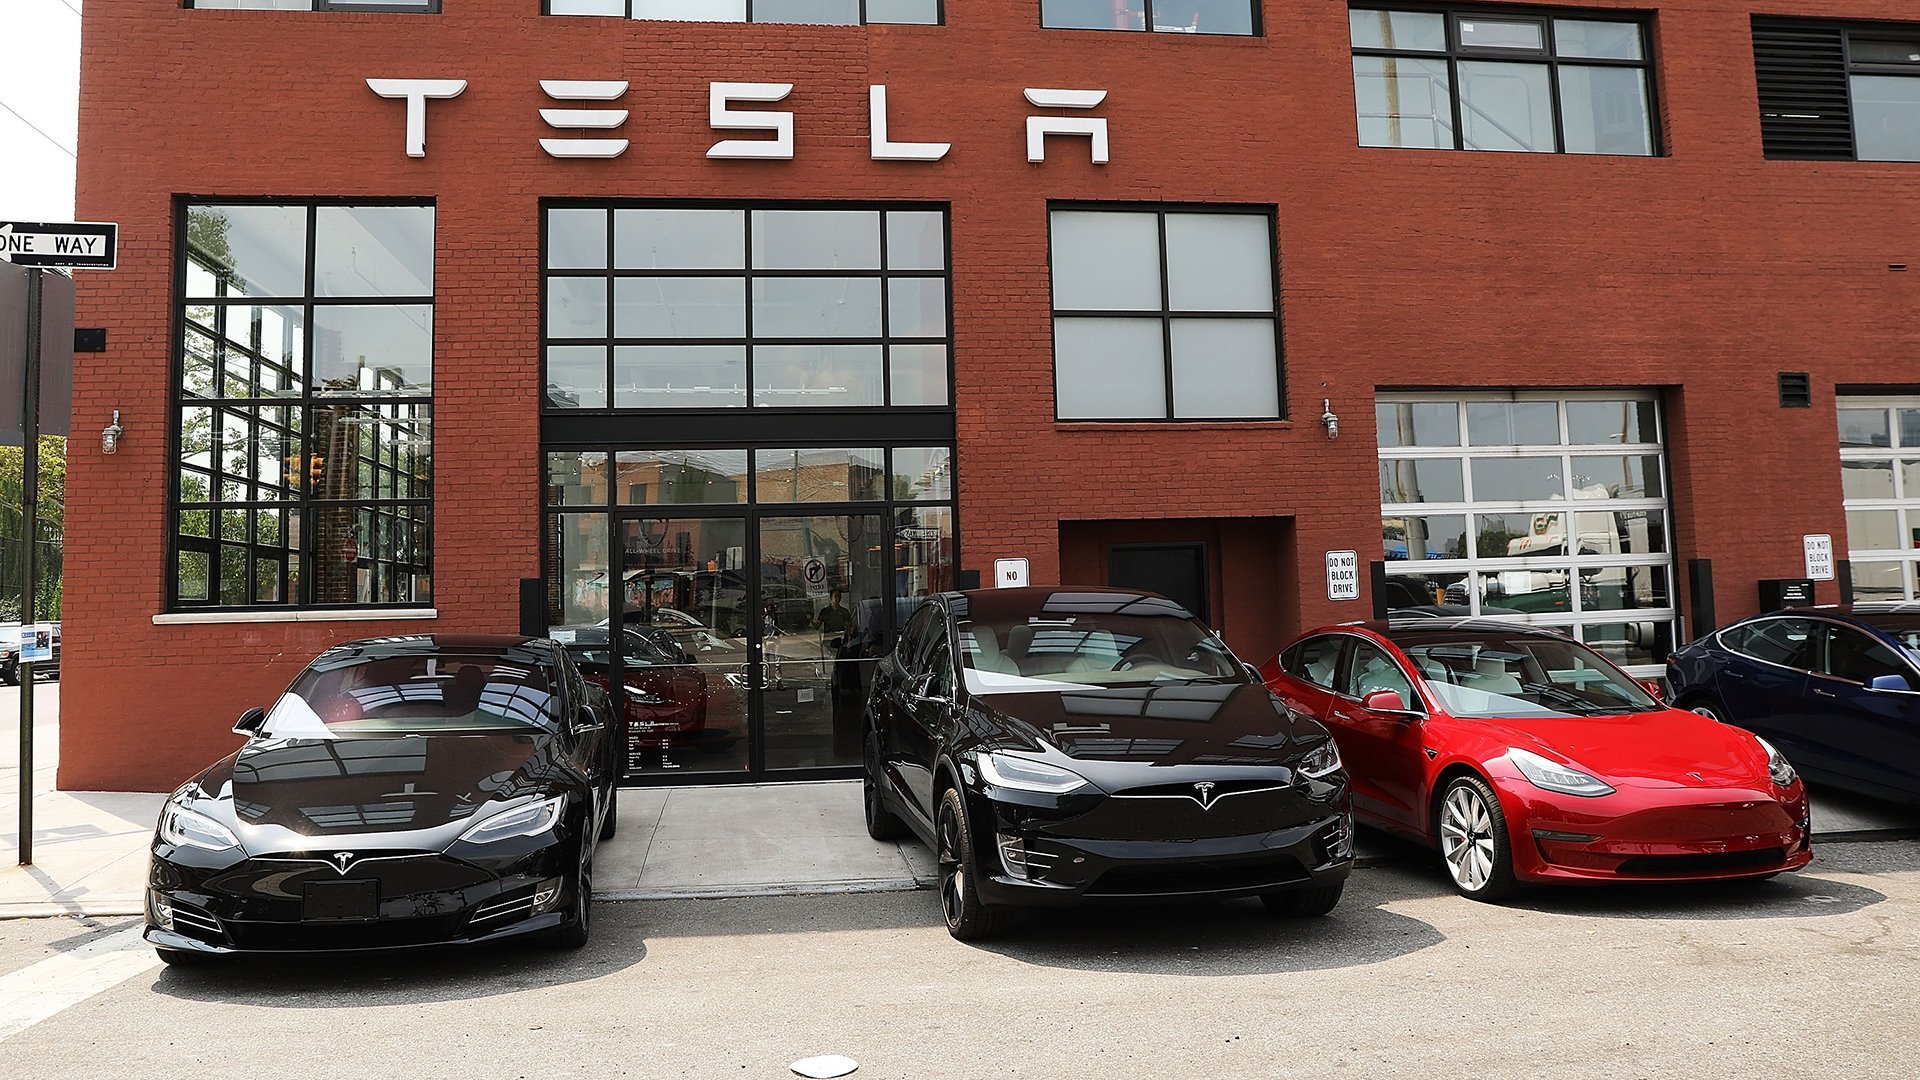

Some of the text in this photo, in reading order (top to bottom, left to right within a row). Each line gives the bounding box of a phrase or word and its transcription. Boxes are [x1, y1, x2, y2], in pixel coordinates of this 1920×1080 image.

[366, 78, 1109, 165] TESLA
[55, 237, 97, 254] WAY
[1807, 540, 1829, 550] DO NOT
[1329, 557, 1353, 567] DO NOT
[1809, 553, 1829, 562] BLOCK
[1811, 565, 1829, 574] DRIVE
[1006, 570, 1018, 581] NO
[1331, 571, 1354, 580] BLOCK
[1333, 584, 1353, 593] DRIVE
